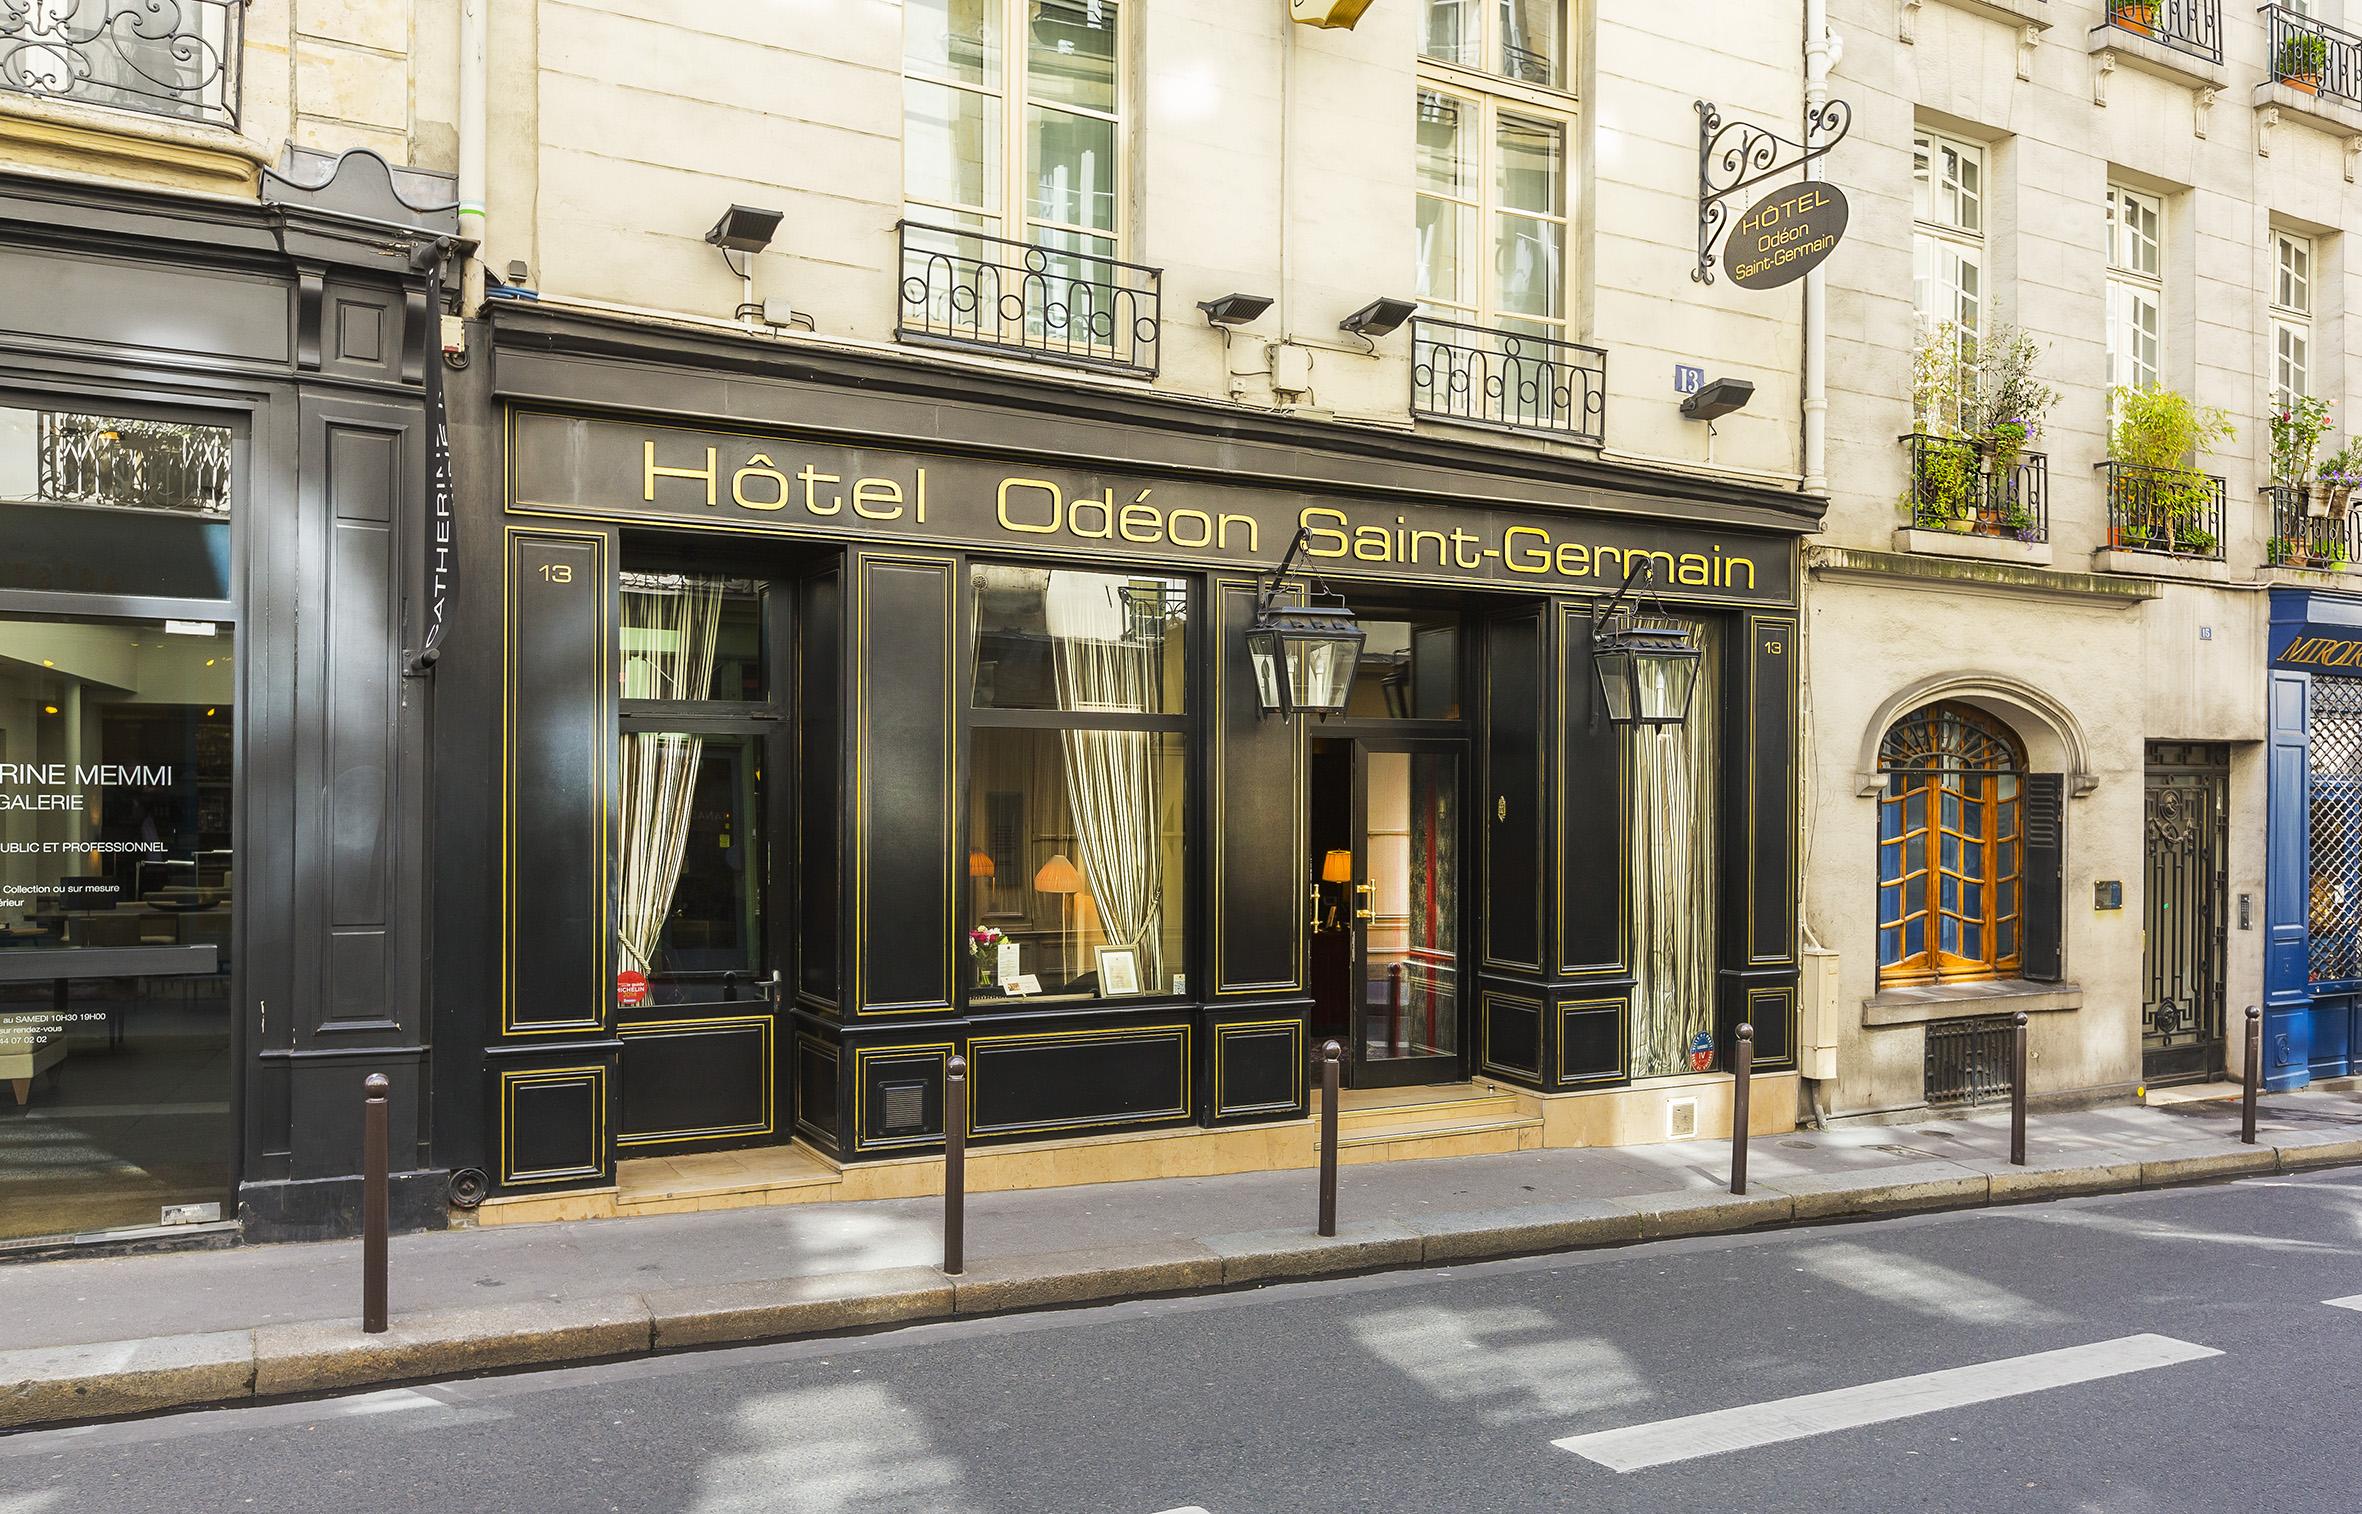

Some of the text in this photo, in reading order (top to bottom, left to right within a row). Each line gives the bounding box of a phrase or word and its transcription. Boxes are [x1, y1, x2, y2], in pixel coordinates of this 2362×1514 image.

[1742, 190, 1830, 235] HÔTEL
[1758, 223, 1809, 252] Odéon
[1735, 233, 1835, 280] Saint-Germain
[1680, 368, 1698, 393] 13
[643, 440, 1756, 590] Hôtel Odéon Saint-Germain
[538, 564, 572, 583] 13
[1764, 641, 1782, 654] 13
[0, 763, 172, 786] RINE MEMMI
[0, 794, 84, 810] GALERIE
[0, 842, 168, 853] UBLIC ET PROFESSIONNEL
[3, 885, 51, 894] Collection
[67, 885, 83, 893] sur
[85, 885, 120, 893] mesure
[15, 1015, 49, 1023] SAMEDI
[51, 1014, 78, 1022] 10H30
[80, 1013, 106, 1021] 19H00
[13, 1025, 62, 1034] rendez-vous
[24, 1036, 34, 1044] 02
[36, 1035, 47, 1043] 02
